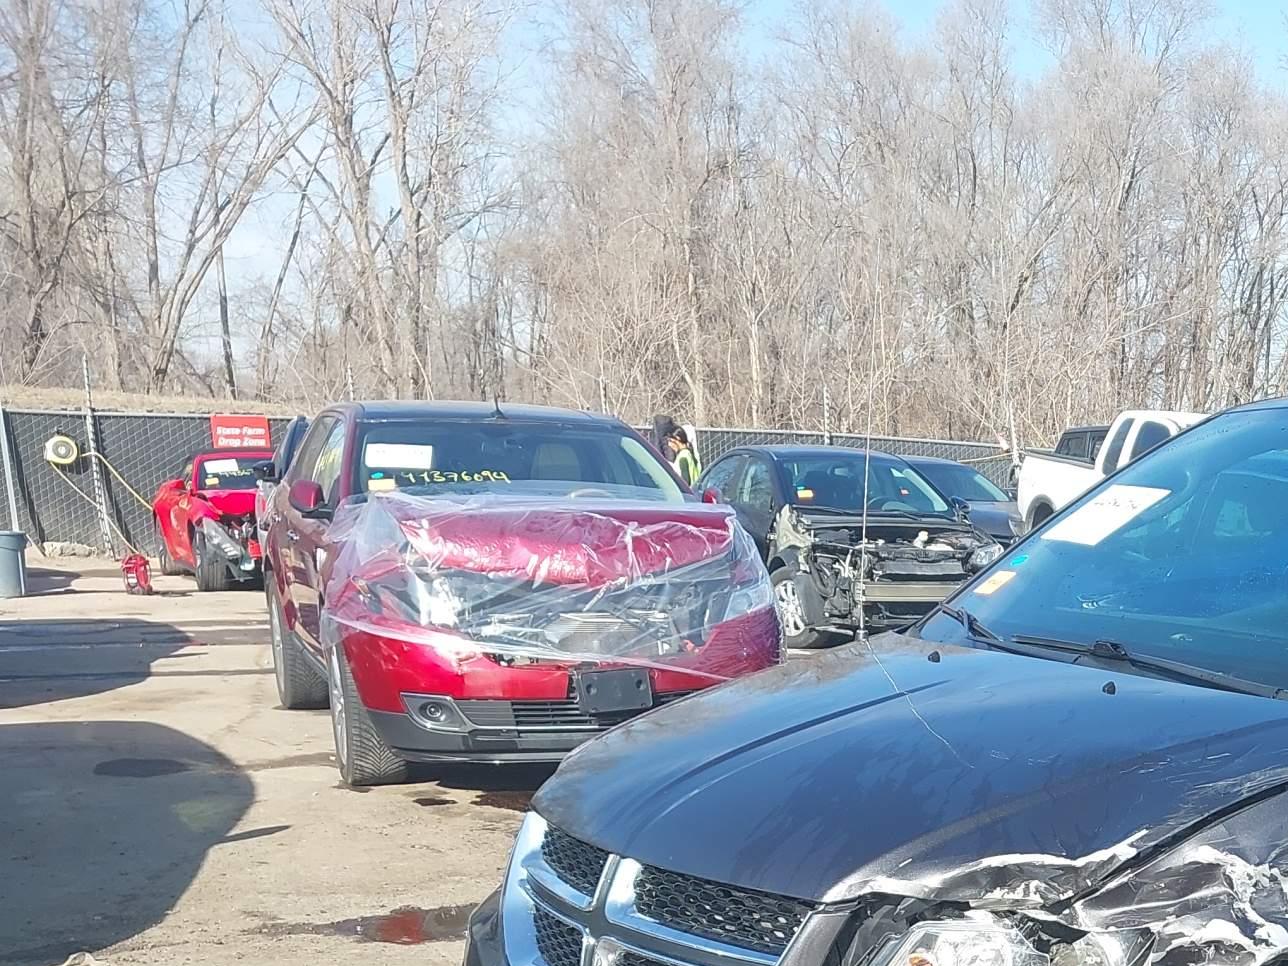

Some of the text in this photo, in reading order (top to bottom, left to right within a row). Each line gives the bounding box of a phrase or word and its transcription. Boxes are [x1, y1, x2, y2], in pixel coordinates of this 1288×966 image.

[216, 426, 265, 435] State Farm
[217, 437, 241, 447] Drop
